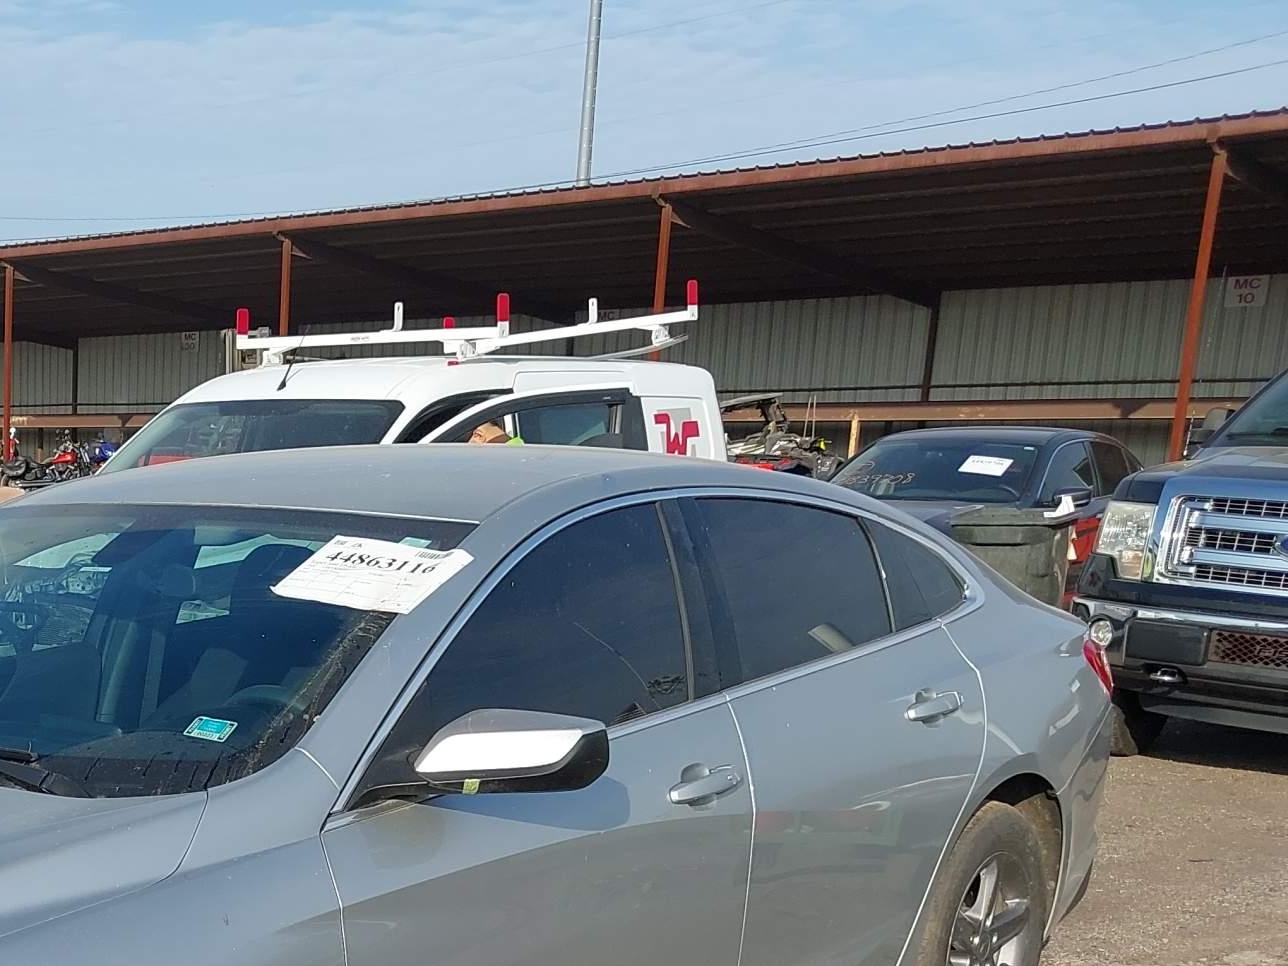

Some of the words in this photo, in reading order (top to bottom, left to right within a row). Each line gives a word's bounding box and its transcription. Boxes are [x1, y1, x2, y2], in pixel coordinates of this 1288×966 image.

[1233, 278, 1261, 290] MC
[1236, 292, 1255, 304] 10
[326, 551, 438, 574] 44863116
